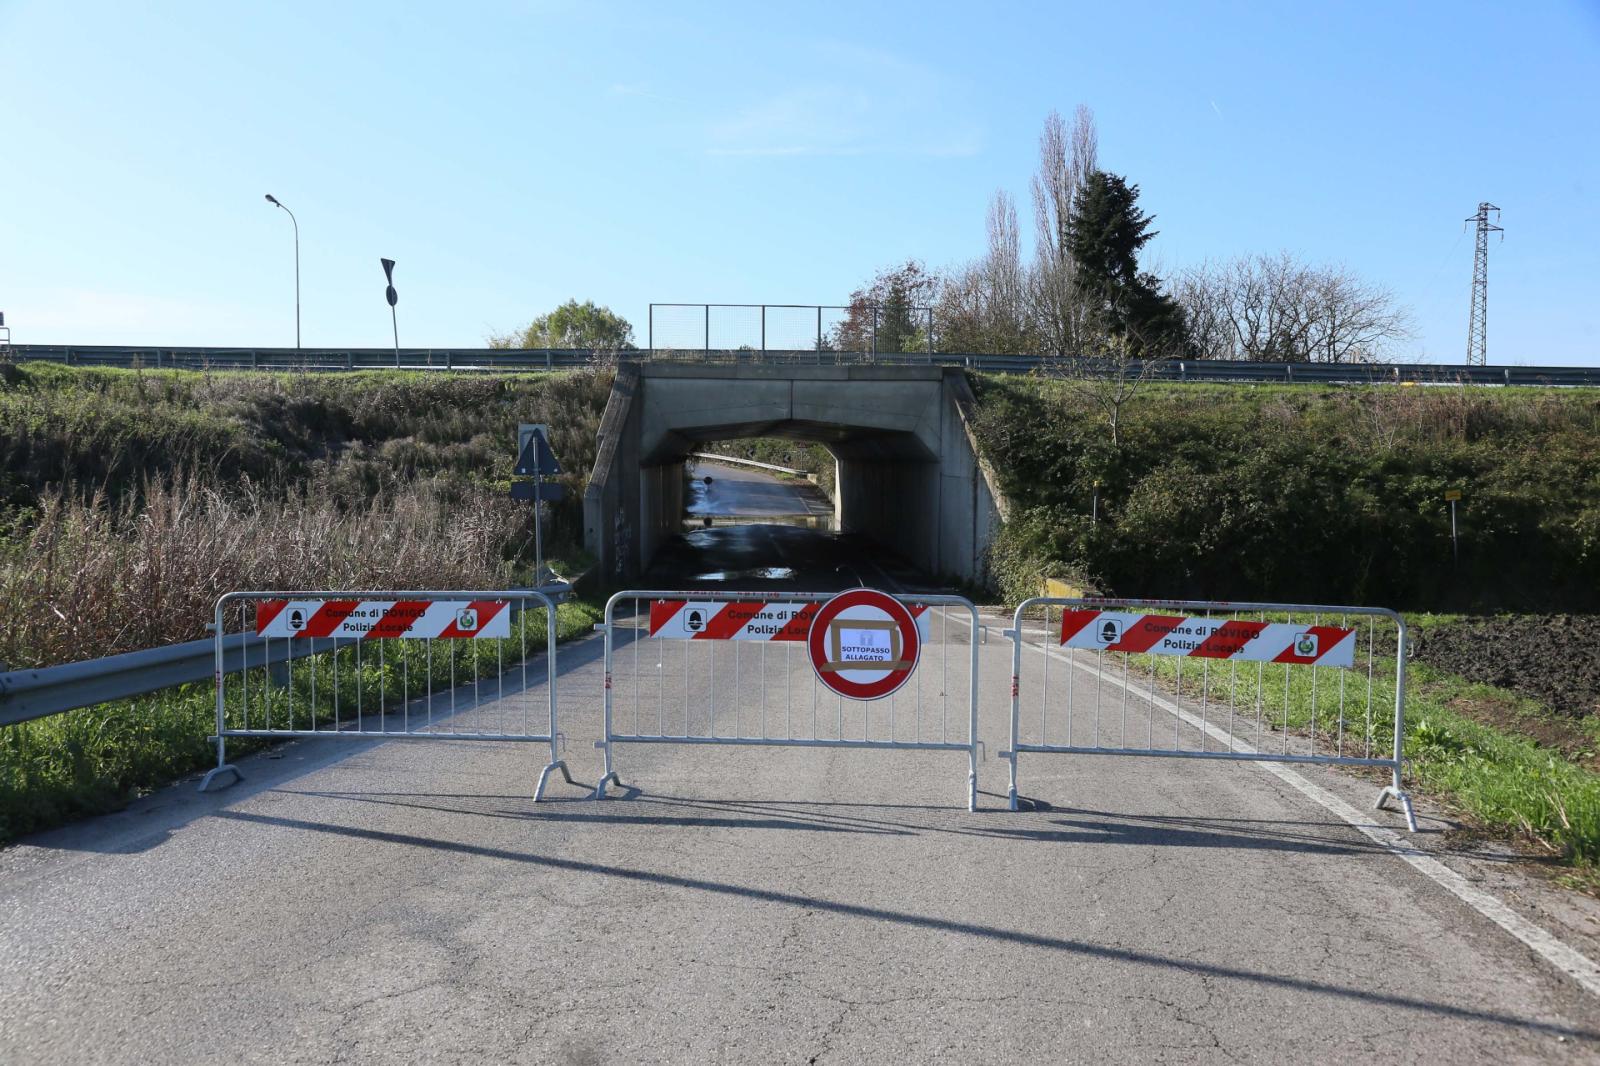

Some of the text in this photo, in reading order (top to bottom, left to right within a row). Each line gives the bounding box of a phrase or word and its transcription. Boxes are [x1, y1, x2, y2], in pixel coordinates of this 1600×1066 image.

[326, 609, 426, 618] Comune di ROVIGO
[728, 610, 774, 620] Comune
[777, 610, 787, 620] di
[343, 623, 414, 632] Polizia Locale
[747, 624, 783, 635] Polizia
[1144, 623, 1260, 640] Comune di ROVIGO
[841, 646, 890, 654] SOTTOPASSO
[1164, 639, 1245, 654] Polizia Locale
